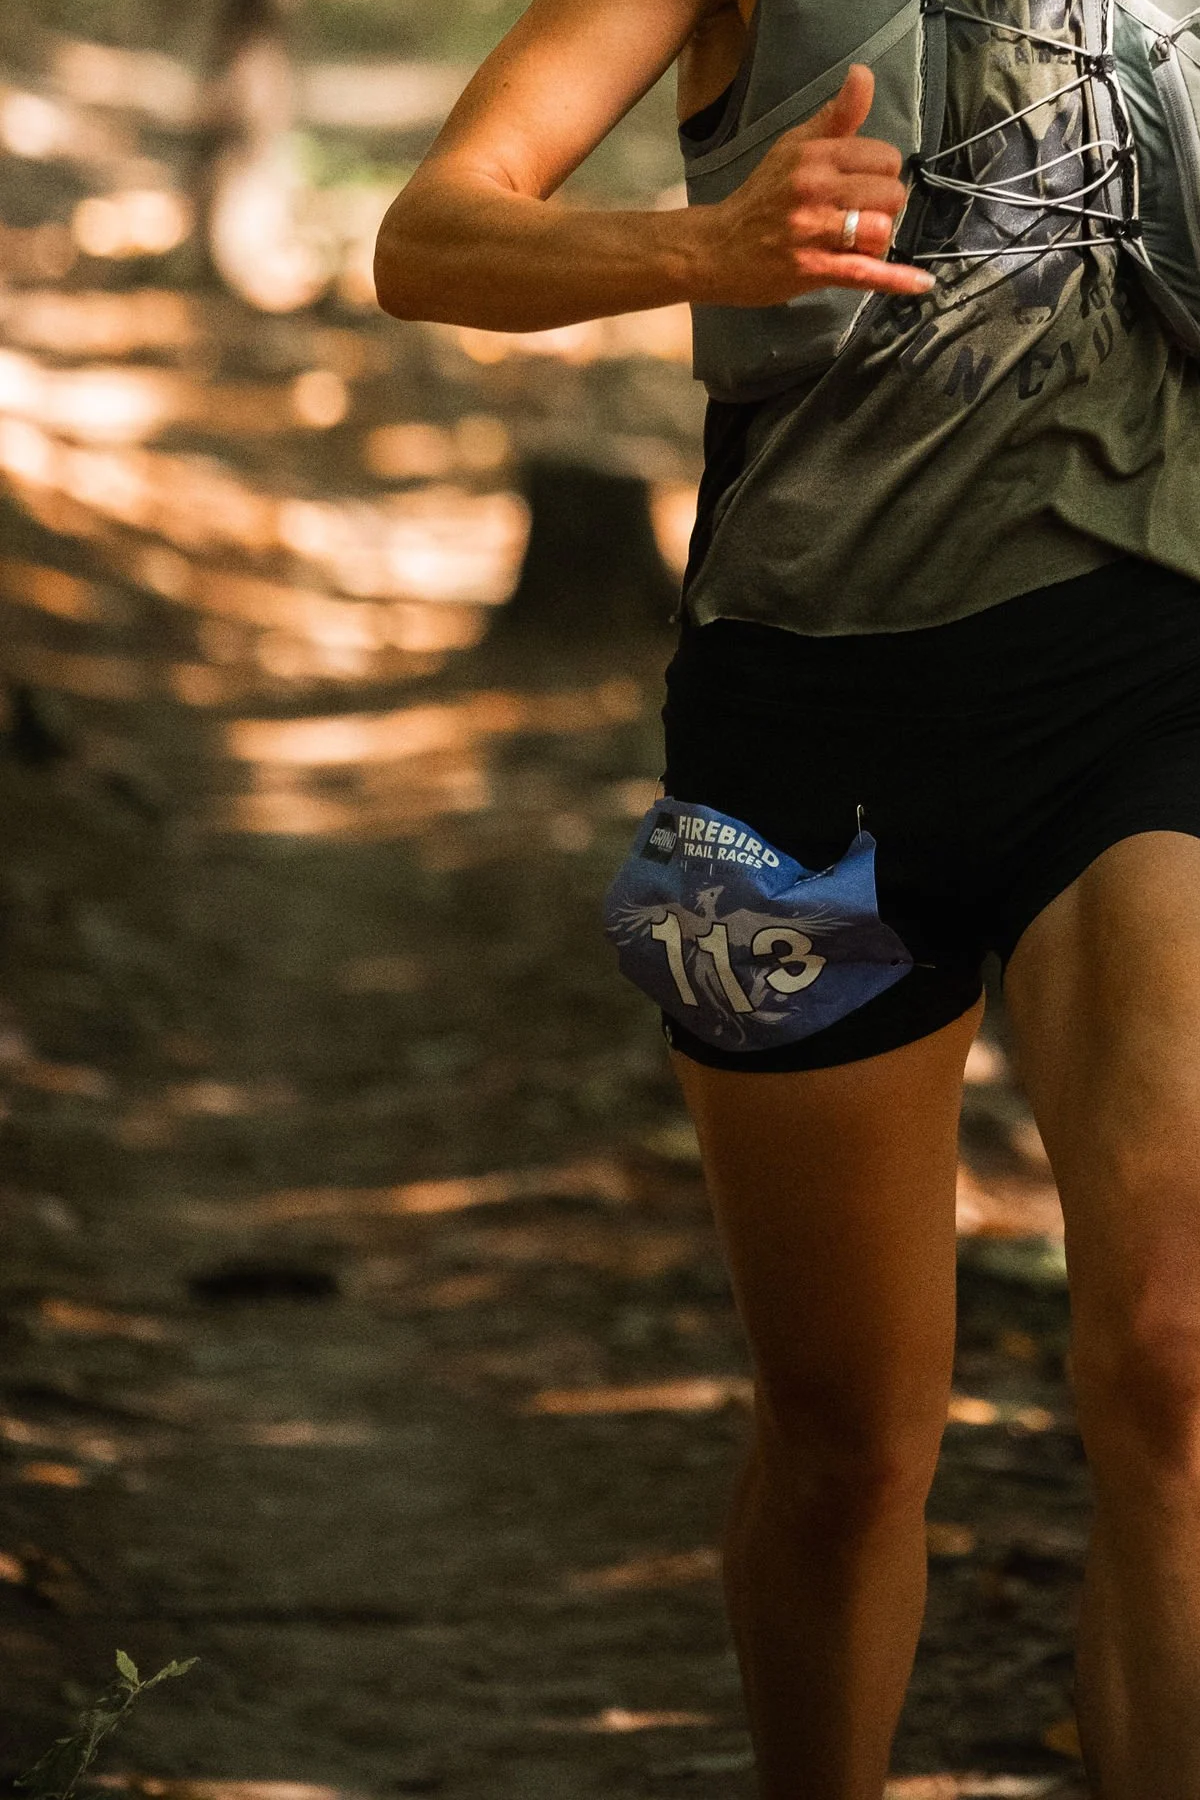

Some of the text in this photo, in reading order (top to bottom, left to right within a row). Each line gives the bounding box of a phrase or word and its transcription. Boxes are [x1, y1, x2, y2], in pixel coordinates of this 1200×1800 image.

[649, 827, 678, 850] GRIND
[678, 815, 780, 868] FIREBIRD
[684, 842, 764, 869] TRAIL RACES
[651, 911, 828, 1014] 113
